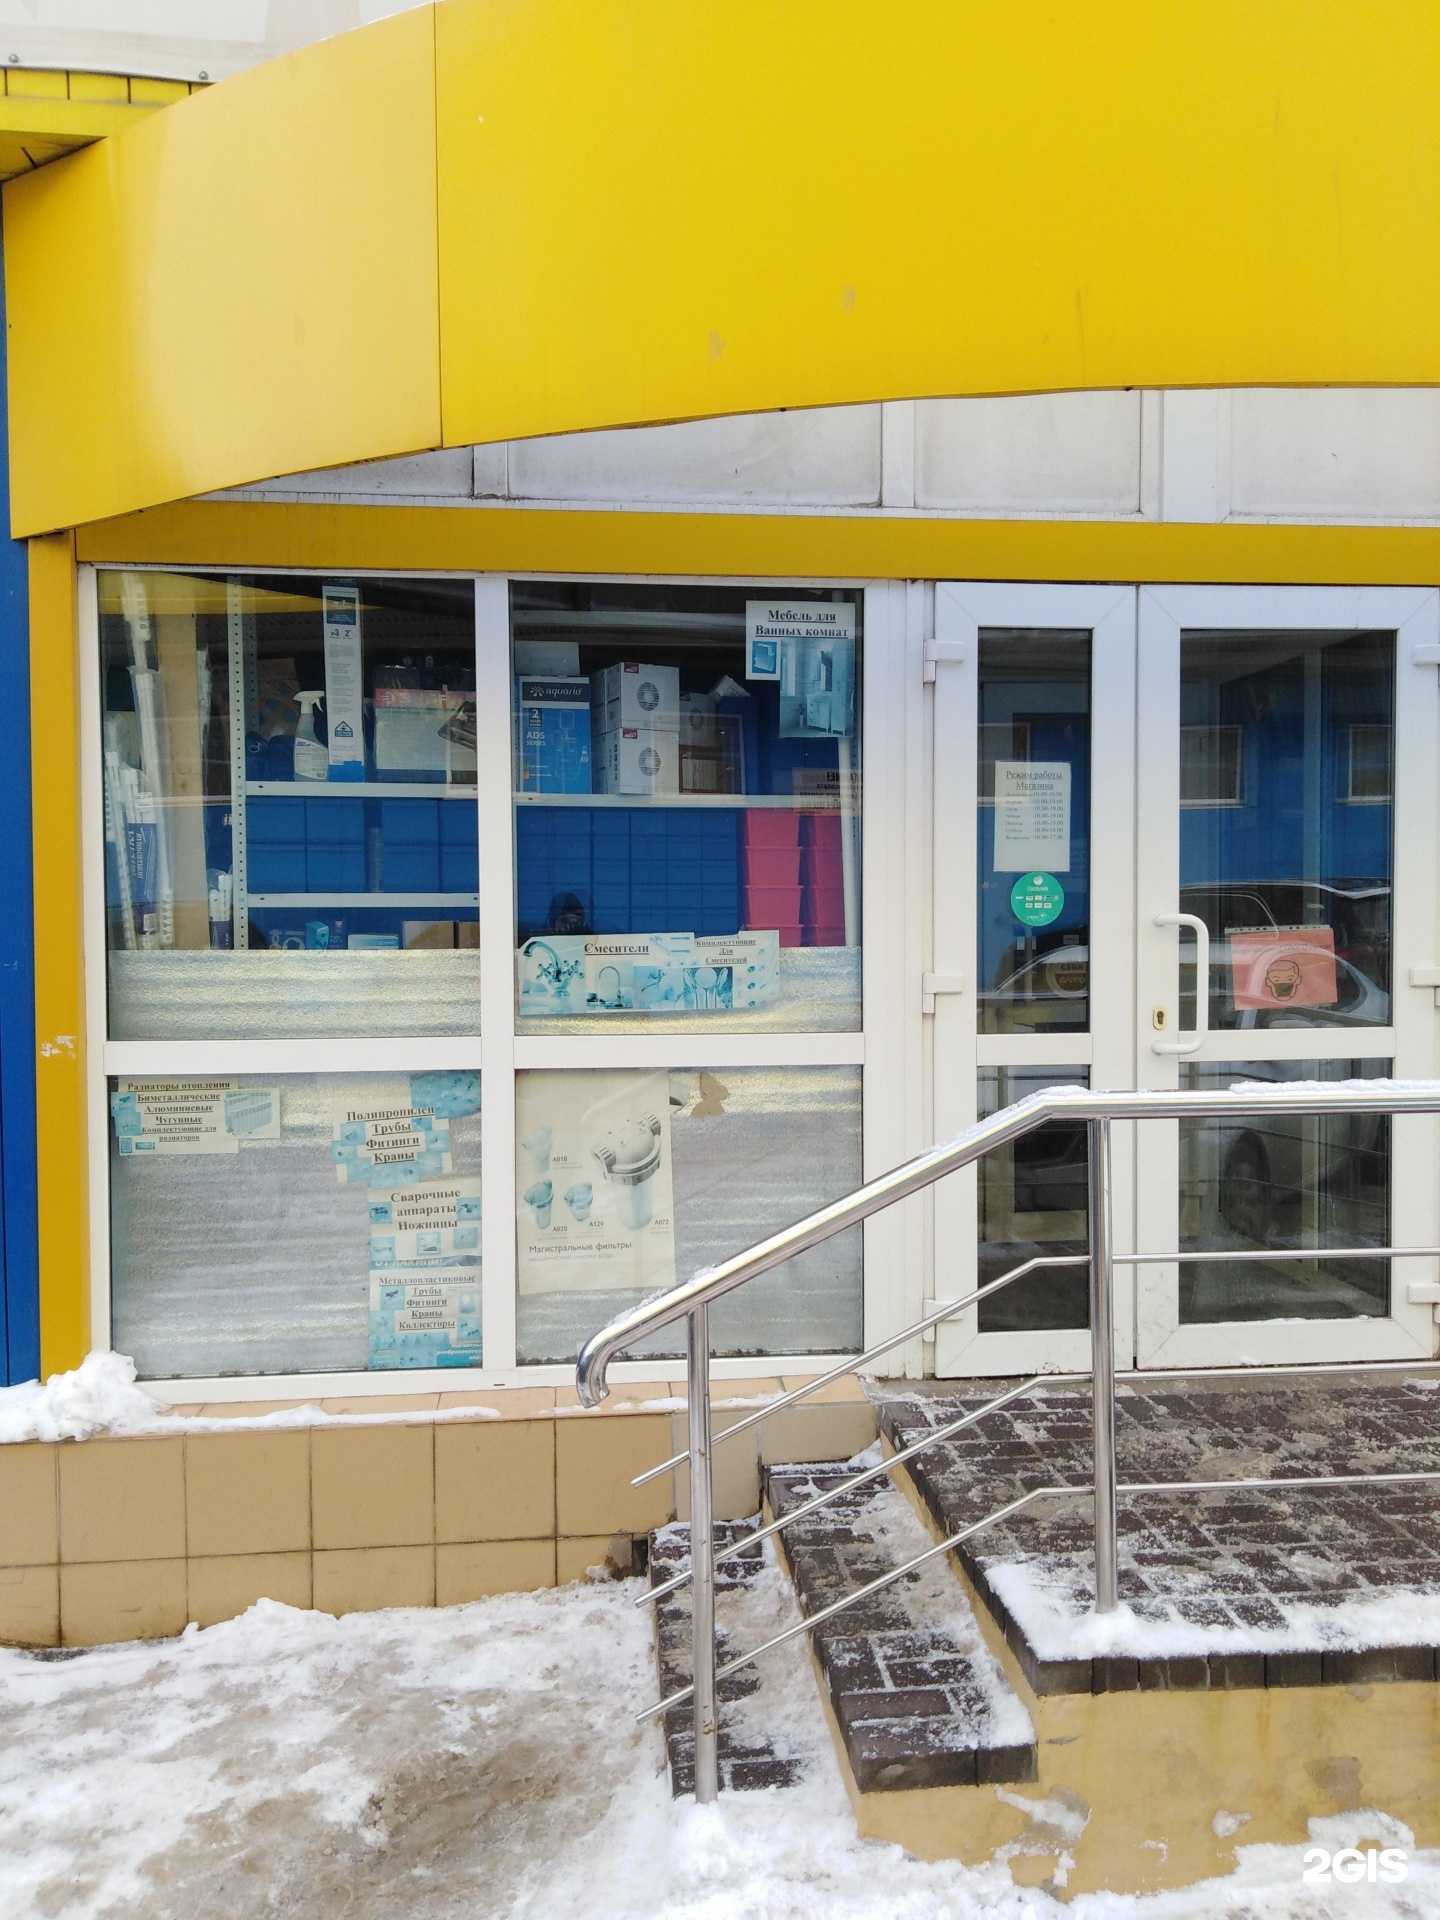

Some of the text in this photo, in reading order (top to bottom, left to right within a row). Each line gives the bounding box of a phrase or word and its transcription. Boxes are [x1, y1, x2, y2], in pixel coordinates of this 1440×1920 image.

[768, 609, 836, 621] Мебель для
[755, 625, 849, 637] Ванных комнат
[584, 943, 649, 953] Смесители
[128, 1081, 230, 1091] Радиаторы отопления
[138, 1093, 221, 1102] Биметаллические
[145, 1105, 214, 1113] Алюминиевые
[346, 1107, 434, 1121] Полипропилен
[156, 1116, 203, 1124] Чугунные
[372, 1122, 411, 1134] Трубы
[366, 1137, 420, 1149] Фитинги
[374, 1152, 415, 1163] Краны
[390, 1190, 460, 1203] Сварочные
[397, 1205, 456, 1217] аппараты
[397, 1220, 458, 1231] Ножницы
[529, 1242, 632, 1254] Магистральные фильтры
[413, 1287, 442, 1296] Трубы
[406, 1299, 448, 1307] Фитинги
[411, 1310, 442, 1319] Краны
[399, 1320, 456, 1330] Коллекторы
